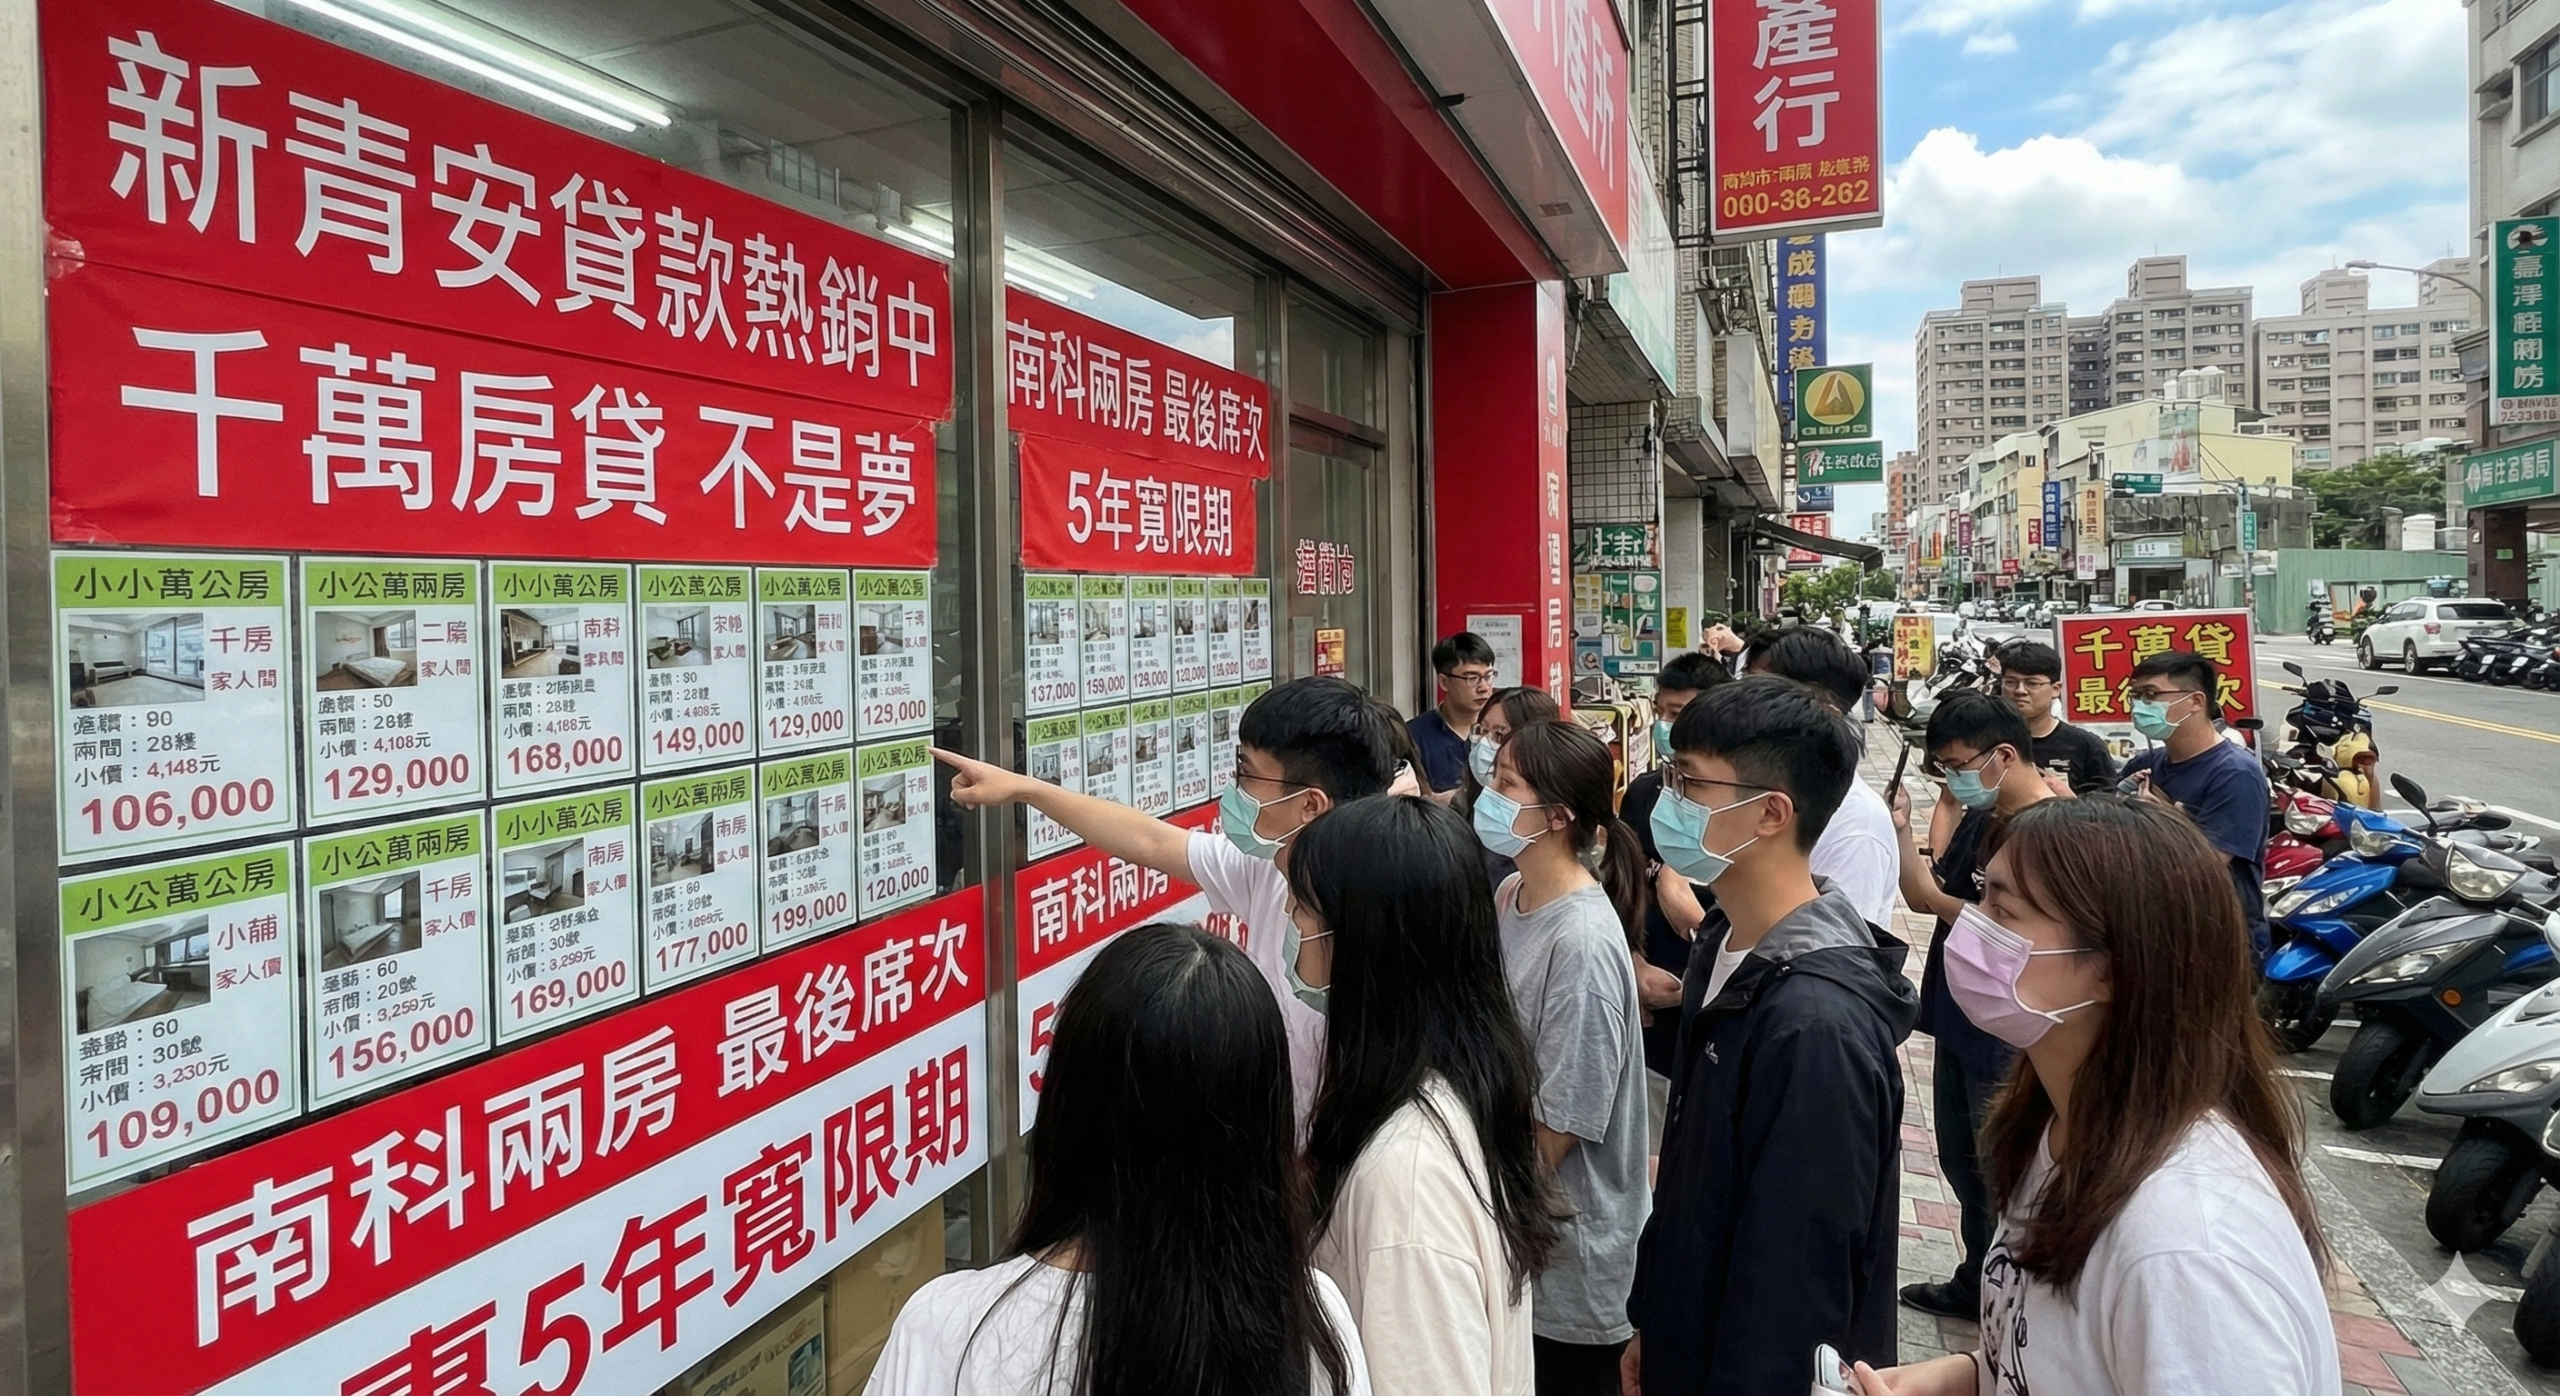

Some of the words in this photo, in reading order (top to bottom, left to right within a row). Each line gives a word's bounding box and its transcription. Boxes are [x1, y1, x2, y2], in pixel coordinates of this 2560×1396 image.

[107, 30, 936, 387] 新青安貸款熱銷中
[1006, 318, 1154, 436] 南科兩房
[1162, 368, 1265, 462] 最後席次
[120, 326, 667, 525] 千萬房貸
[699, 405, 915, 537] 不是夢
[1067, 467, 1232, 557] 5年寬限期
[73, 567, 270, 600] 小小萬公房
[318, 570, 466, 600] 小公萬兩房
[503, 572, 619, 598] 小小萬公房
[209, 625, 273, 654] 千房
[2074, 622, 2236, 669] 千萬貸
[211, 669, 278, 691] 家人間
[652, 720, 744, 754] 149,000
[768, 709, 843, 739] 129,000
[324, 753, 470, 800] 129,000
[507, 735, 623, 775] 168,000
[81, 777, 275, 835] 106,000
[506, 797, 623, 840] 小小萬公房
[321, 823, 471, 876] 小公萬兩房
[79, 858, 276, 922] 小公萬公房
[425, 872, 473, 902] 千房
[866, 866, 929, 902] 120,000
[772, 891, 847, 934] 199,000
[656, 922, 748, 972] 177,000
[511, 960, 626, 1020] 169,000
[328, 1006, 474, 1080] 156,000
[86, 1068, 280, 1158] 109,000
[187, 1026, 683, 1351] 南科兩房
[716, 917, 971, 1101] 最後席次
